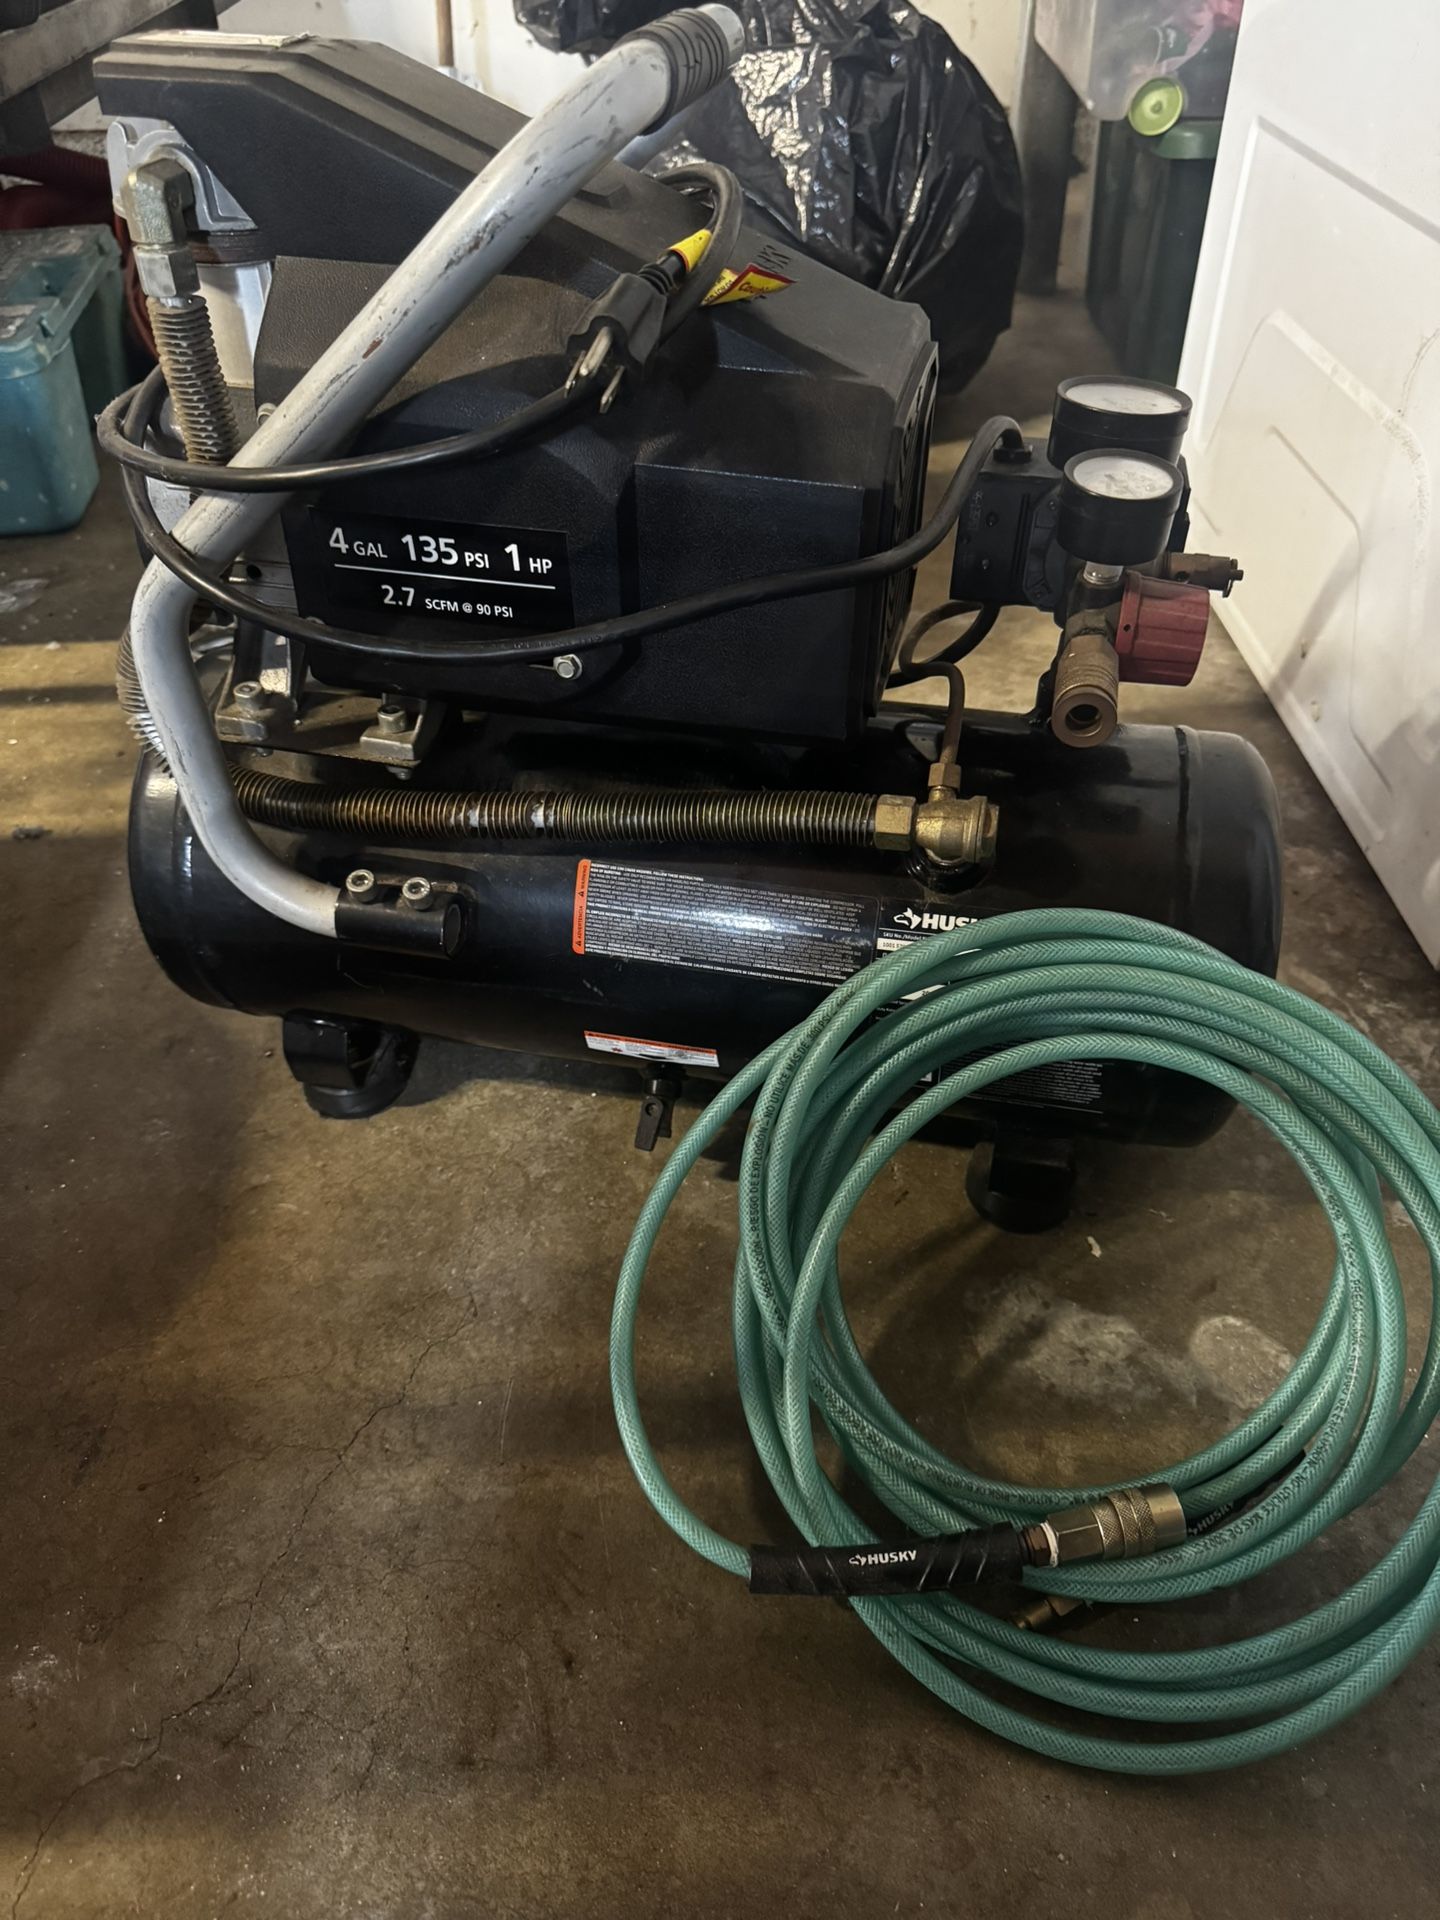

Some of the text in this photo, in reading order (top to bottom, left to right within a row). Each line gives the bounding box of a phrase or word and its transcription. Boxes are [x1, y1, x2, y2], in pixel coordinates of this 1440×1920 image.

[329, 526, 553, 574] 4 GAL 135 PSI 1 HP
[381, 584, 513, 618] 2.7 SCFM @ 90 PSI
[921, 912, 979, 931] HUS
[797, 1042, 810, 1056] DE
[770, 1073, 790, 1104] UTILICE
[764, 1105, 775, 1118] NO
[750, 1181, 760, 1193] DE
[749, 1197, 760, 1232] RIESGO
[867, 1550, 917, 1565] HUSKY
